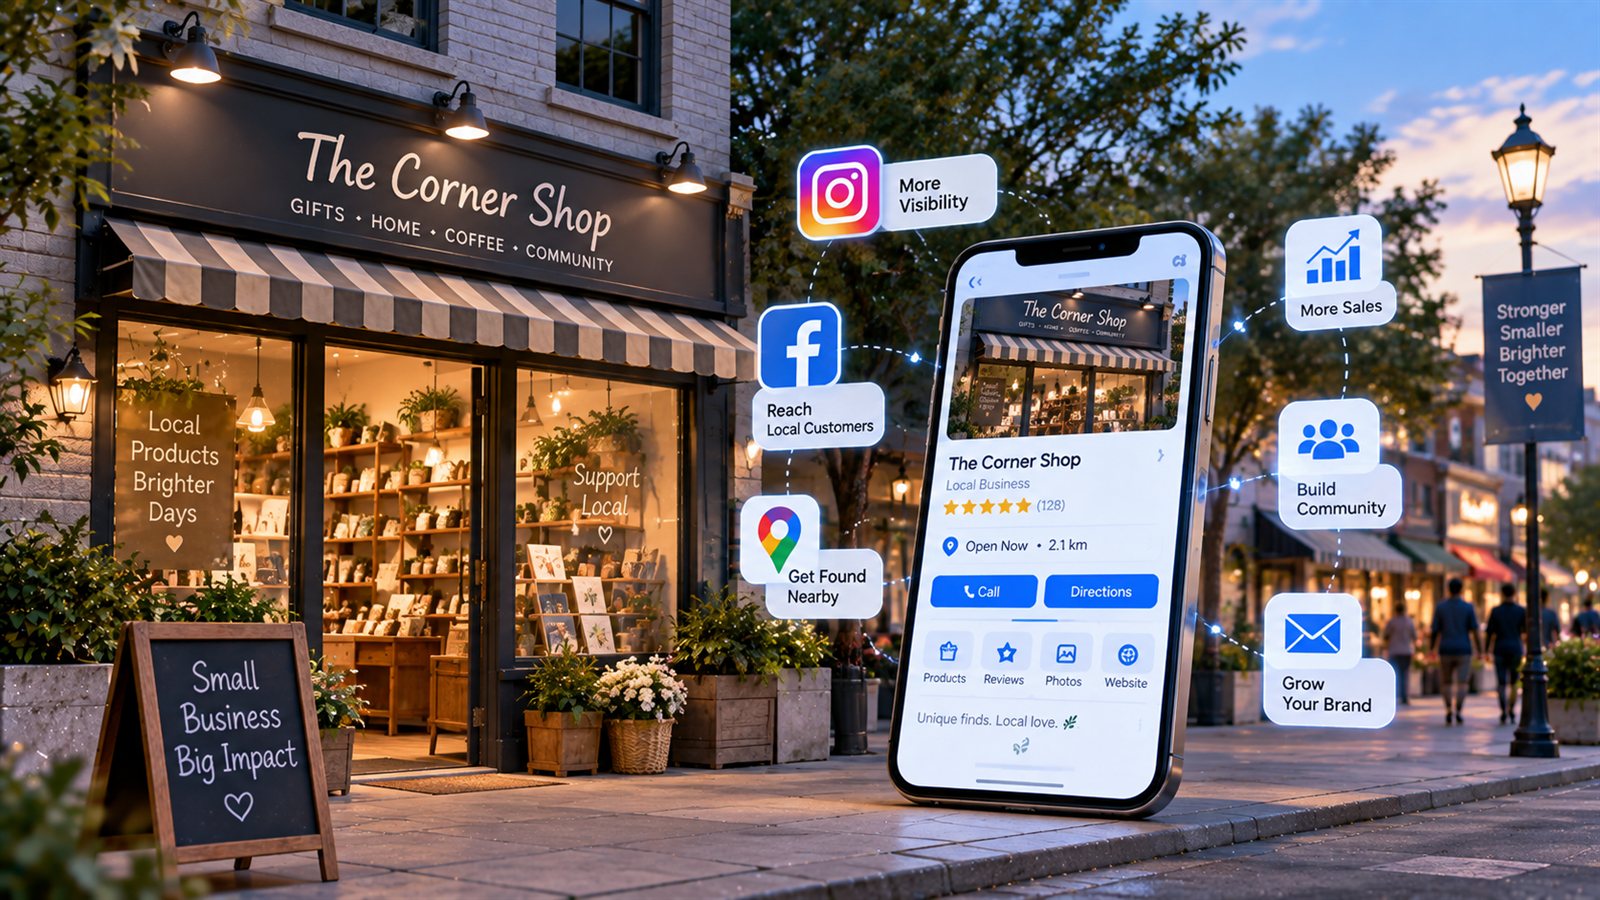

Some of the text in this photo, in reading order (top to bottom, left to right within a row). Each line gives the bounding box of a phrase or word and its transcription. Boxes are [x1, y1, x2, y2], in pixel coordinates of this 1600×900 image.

[297, 131, 611, 252] The Corner Shop
[290, 198, 614, 272] GIFTS HOME COFFEE COMMUNITY
[1023, 300, 1127, 331] The Corner Shop
[1497, 302, 1566, 320] Stronger
[1500, 321, 1564, 341] Smaller
[1499, 343, 1566, 364] Brighter
[1497, 364, 1569, 387] Together
[149, 410, 200, 435] Local
[131, 440, 219, 466] Products
[949, 453, 1081, 471] The Corner Shop
[134, 470, 214, 498] Brighter
[573, 462, 640, 493] Support
[946, 478, 1030, 491] Local Business
[149, 501, 197, 528] Days
[582, 494, 629, 516] Local
[1037, 500, 1066, 512] (128)
[966, 539, 1088, 554] Open Now 2.1 km
[978, 586, 1000, 598] Call
[1071, 586, 1132, 598] Directions
[192, 660, 259, 693] Small
[923, 672, 966, 684] Products
[984, 674, 1024, 685] Reviews
[1045, 676, 1082, 687] Photos
[1104, 677, 1148, 689] Website
[180, 702, 281, 734] Business
[917, 712, 1058, 728] Unique finds. Local love.
[174, 740, 298, 784] Big Impact
